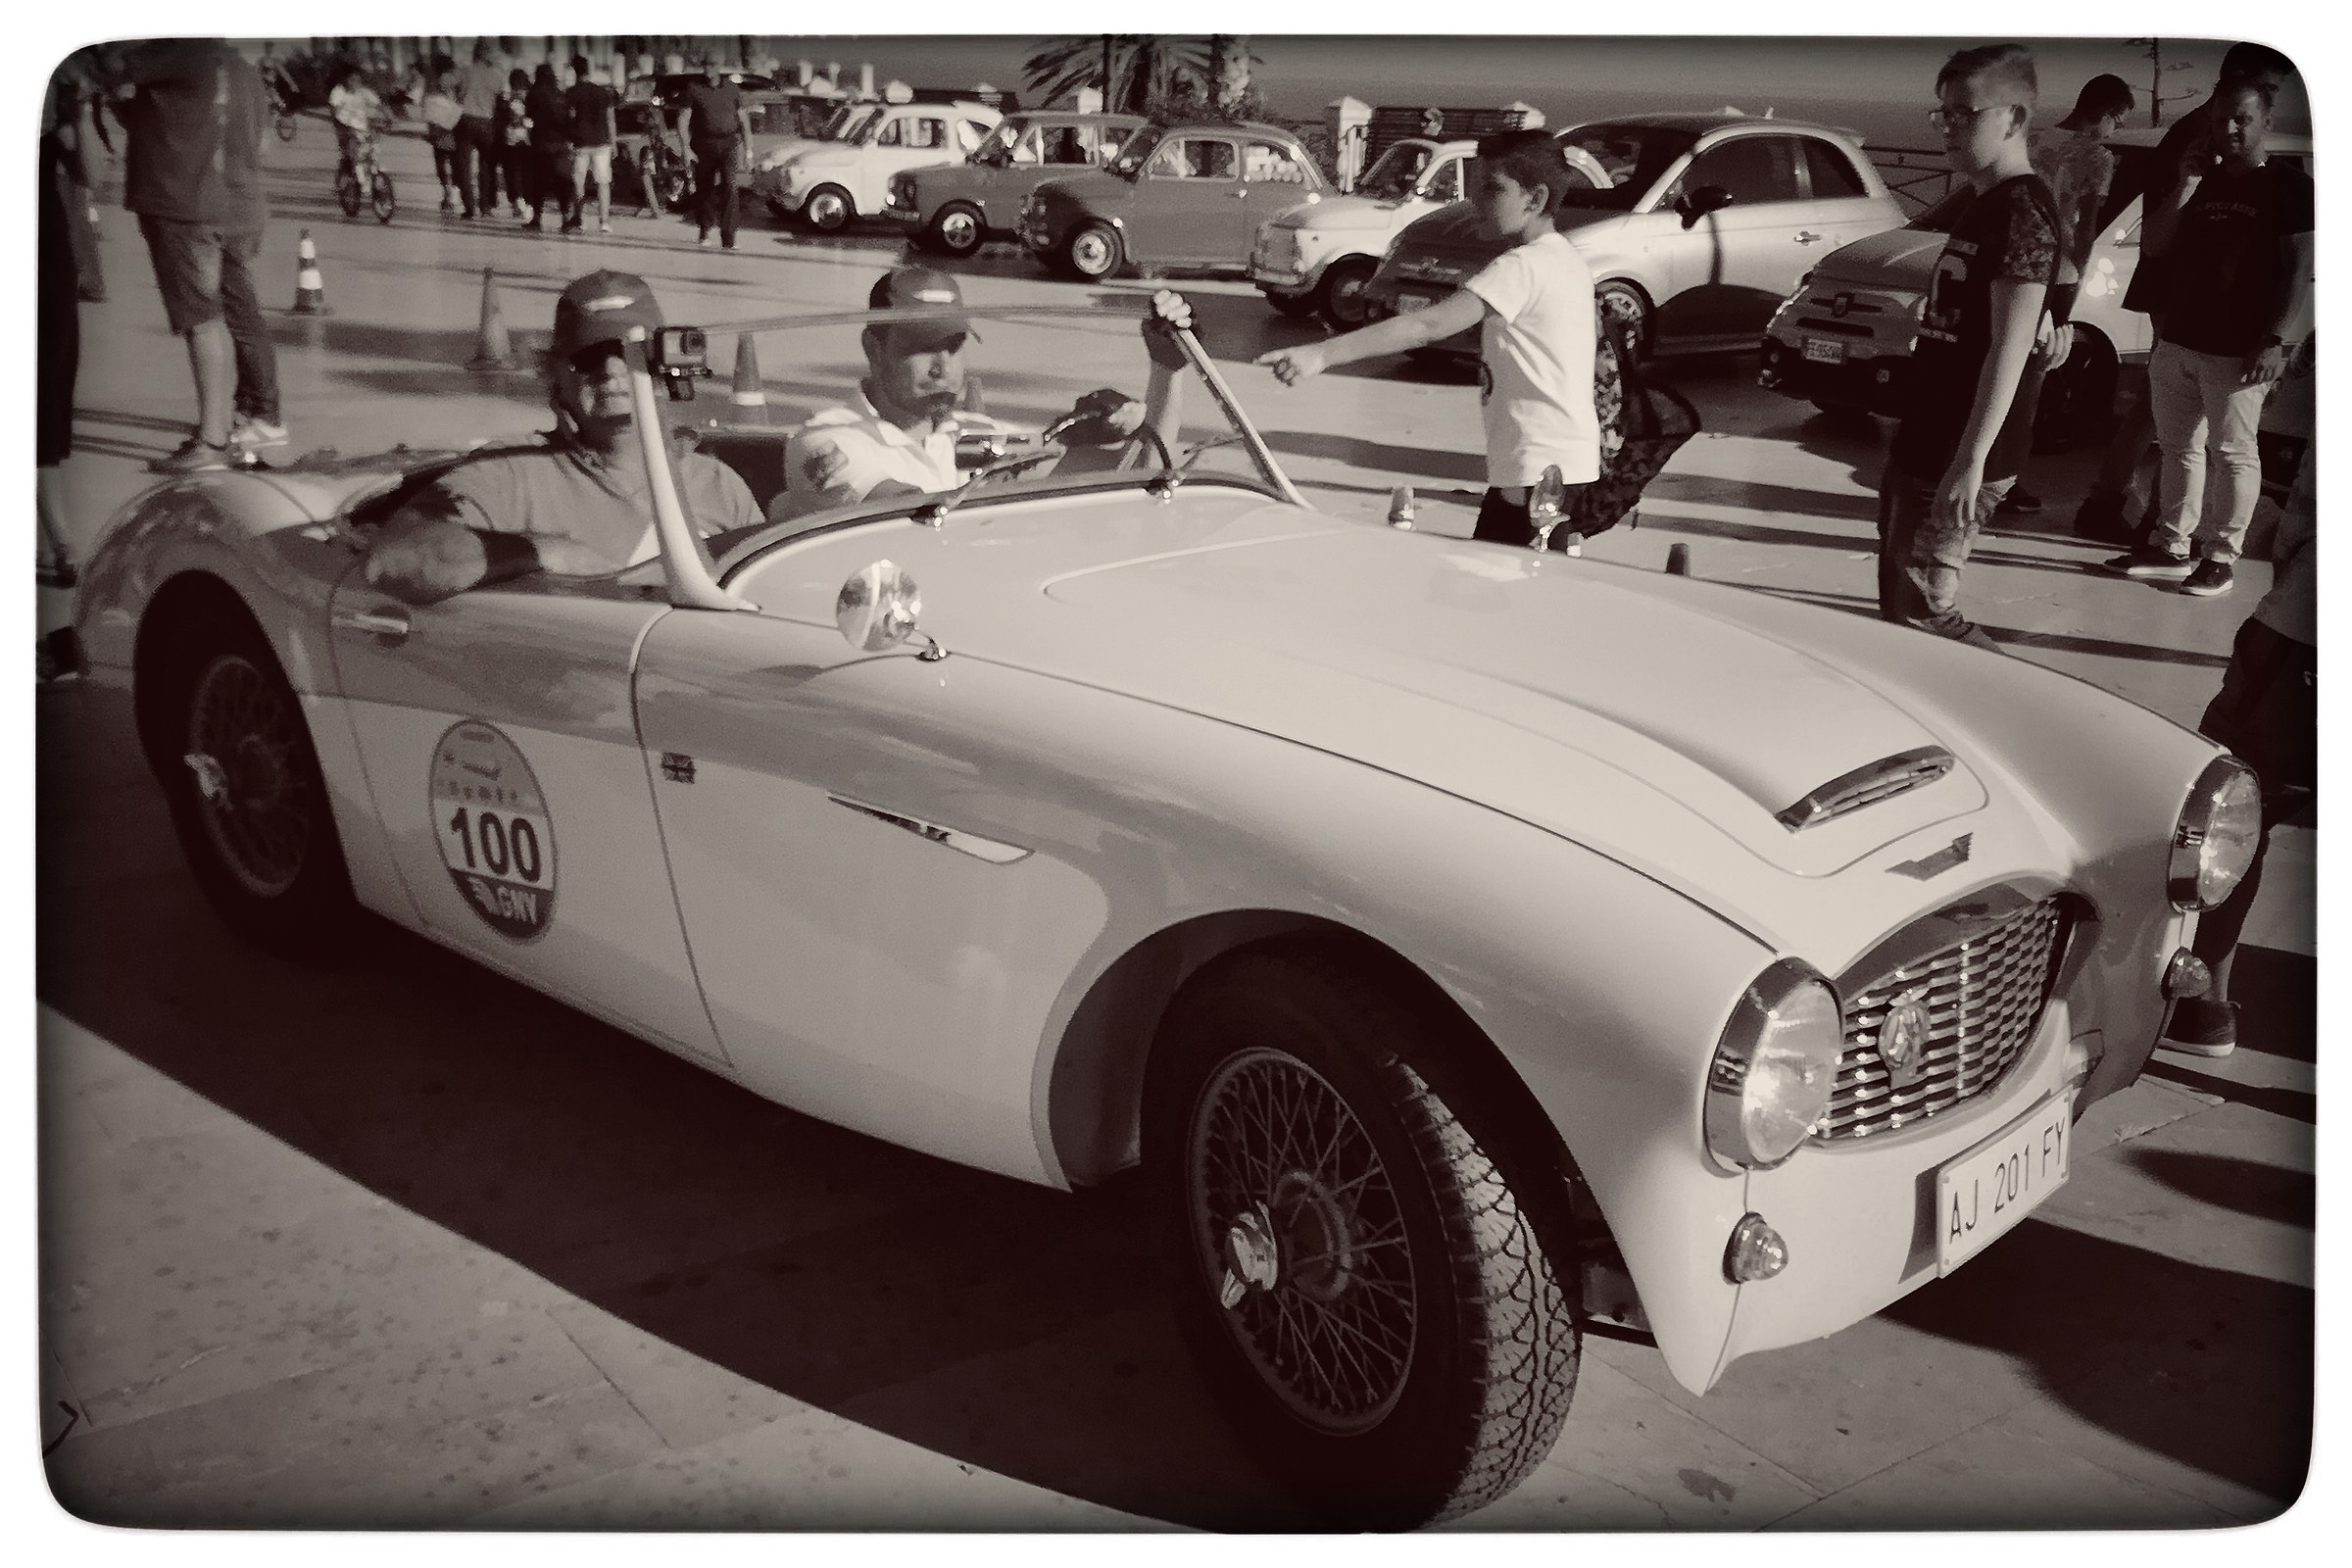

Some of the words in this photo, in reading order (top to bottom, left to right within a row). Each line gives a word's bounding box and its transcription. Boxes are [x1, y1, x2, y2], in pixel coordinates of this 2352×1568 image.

[451, 807, 540, 882] 100
[1950, 1179, 1978, 1245] AJ
[1994, 1145, 2030, 1213] 201
[2042, 1116, 2065, 1178] FY
